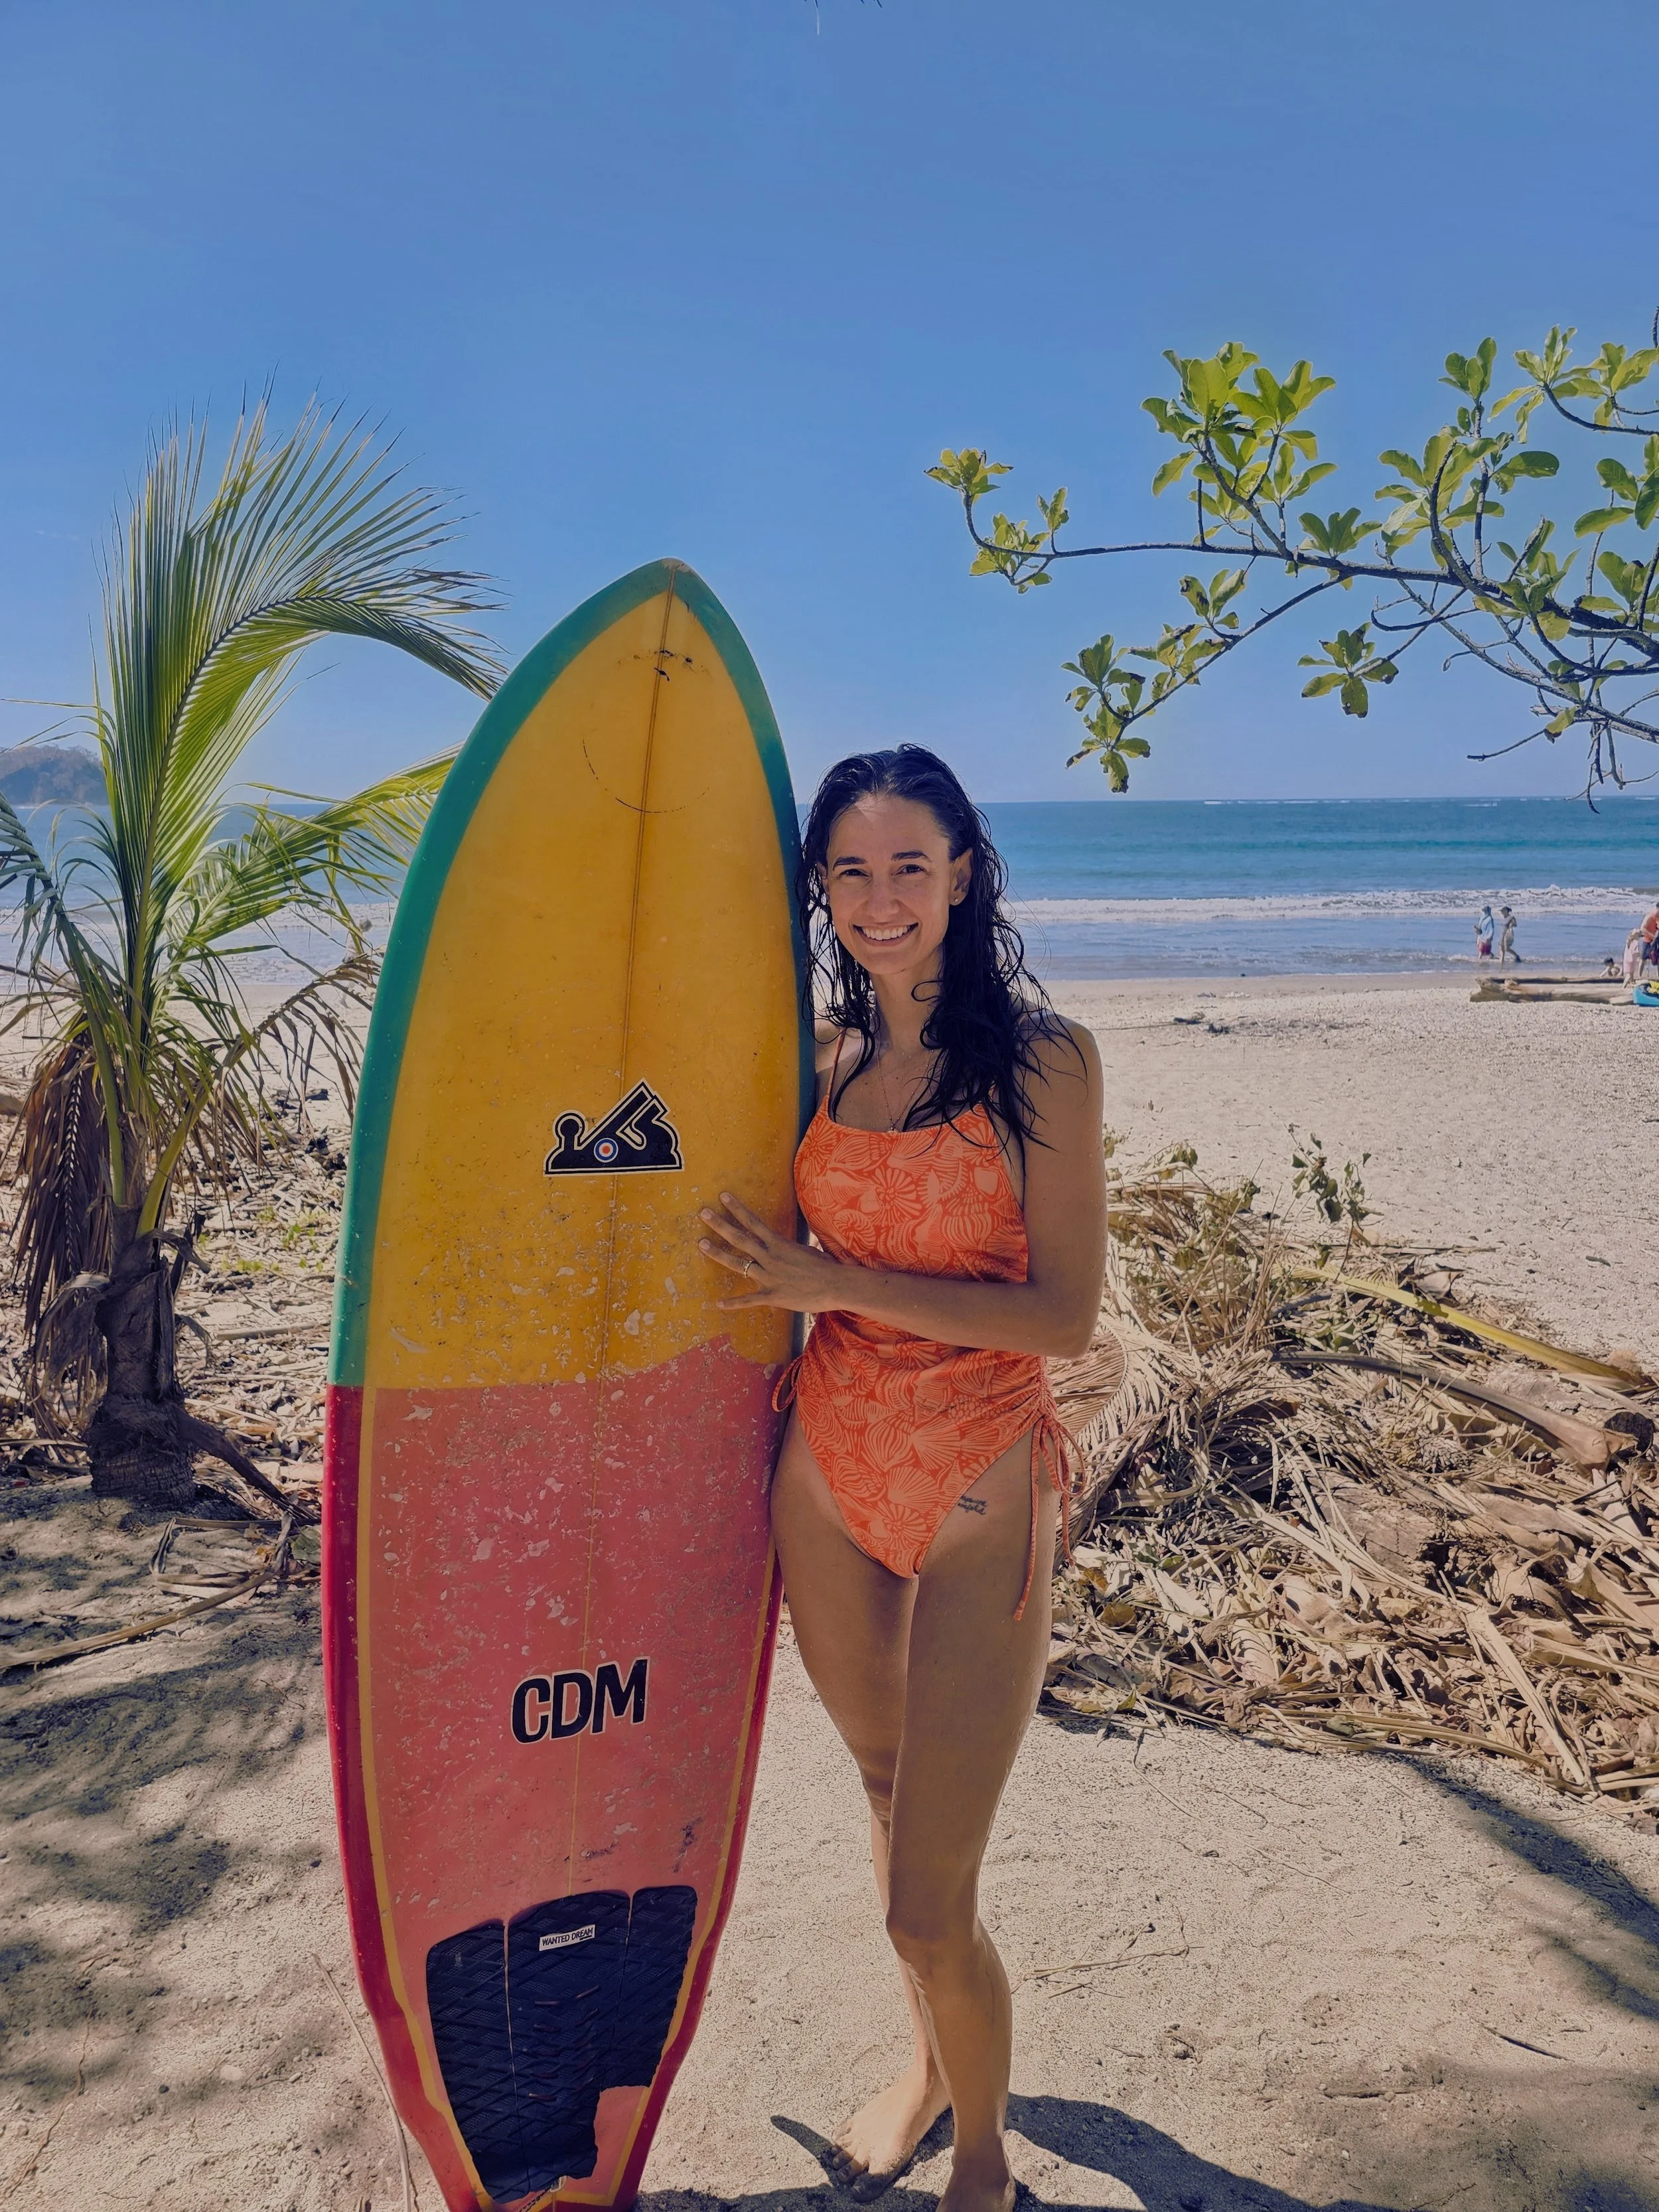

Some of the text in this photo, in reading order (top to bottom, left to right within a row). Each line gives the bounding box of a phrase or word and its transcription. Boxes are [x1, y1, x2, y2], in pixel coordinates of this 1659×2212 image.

[510, 1657, 650, 1744] CDM
[542, 1927, 593, 1946] WANTED DREAM
